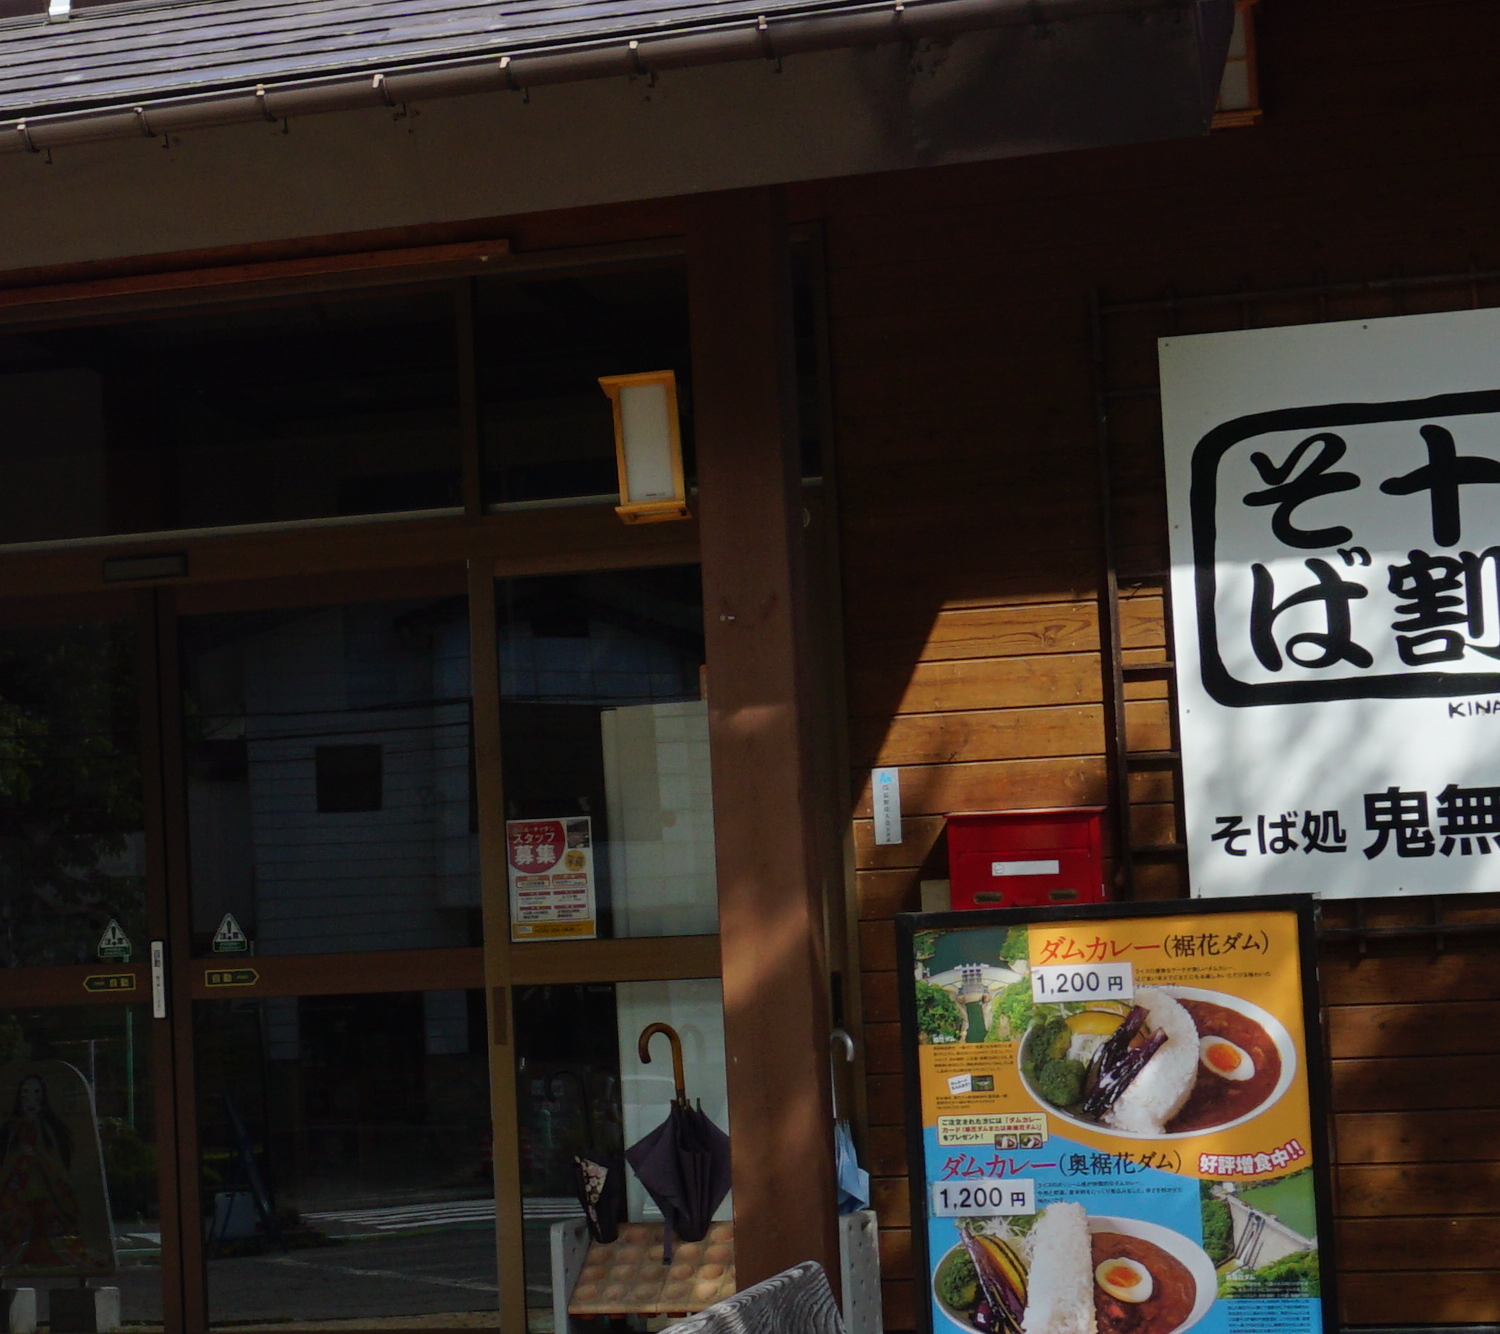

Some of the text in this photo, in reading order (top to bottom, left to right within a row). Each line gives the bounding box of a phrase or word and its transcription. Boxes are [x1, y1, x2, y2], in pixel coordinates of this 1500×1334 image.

[513, 832, 556, 844] スタッフ
[1211, 810, 1348, 857] そば処
[1036, 971, 1123, 996] 1,200 円
[939, 1187, 1026, 1211] 1,200 円
